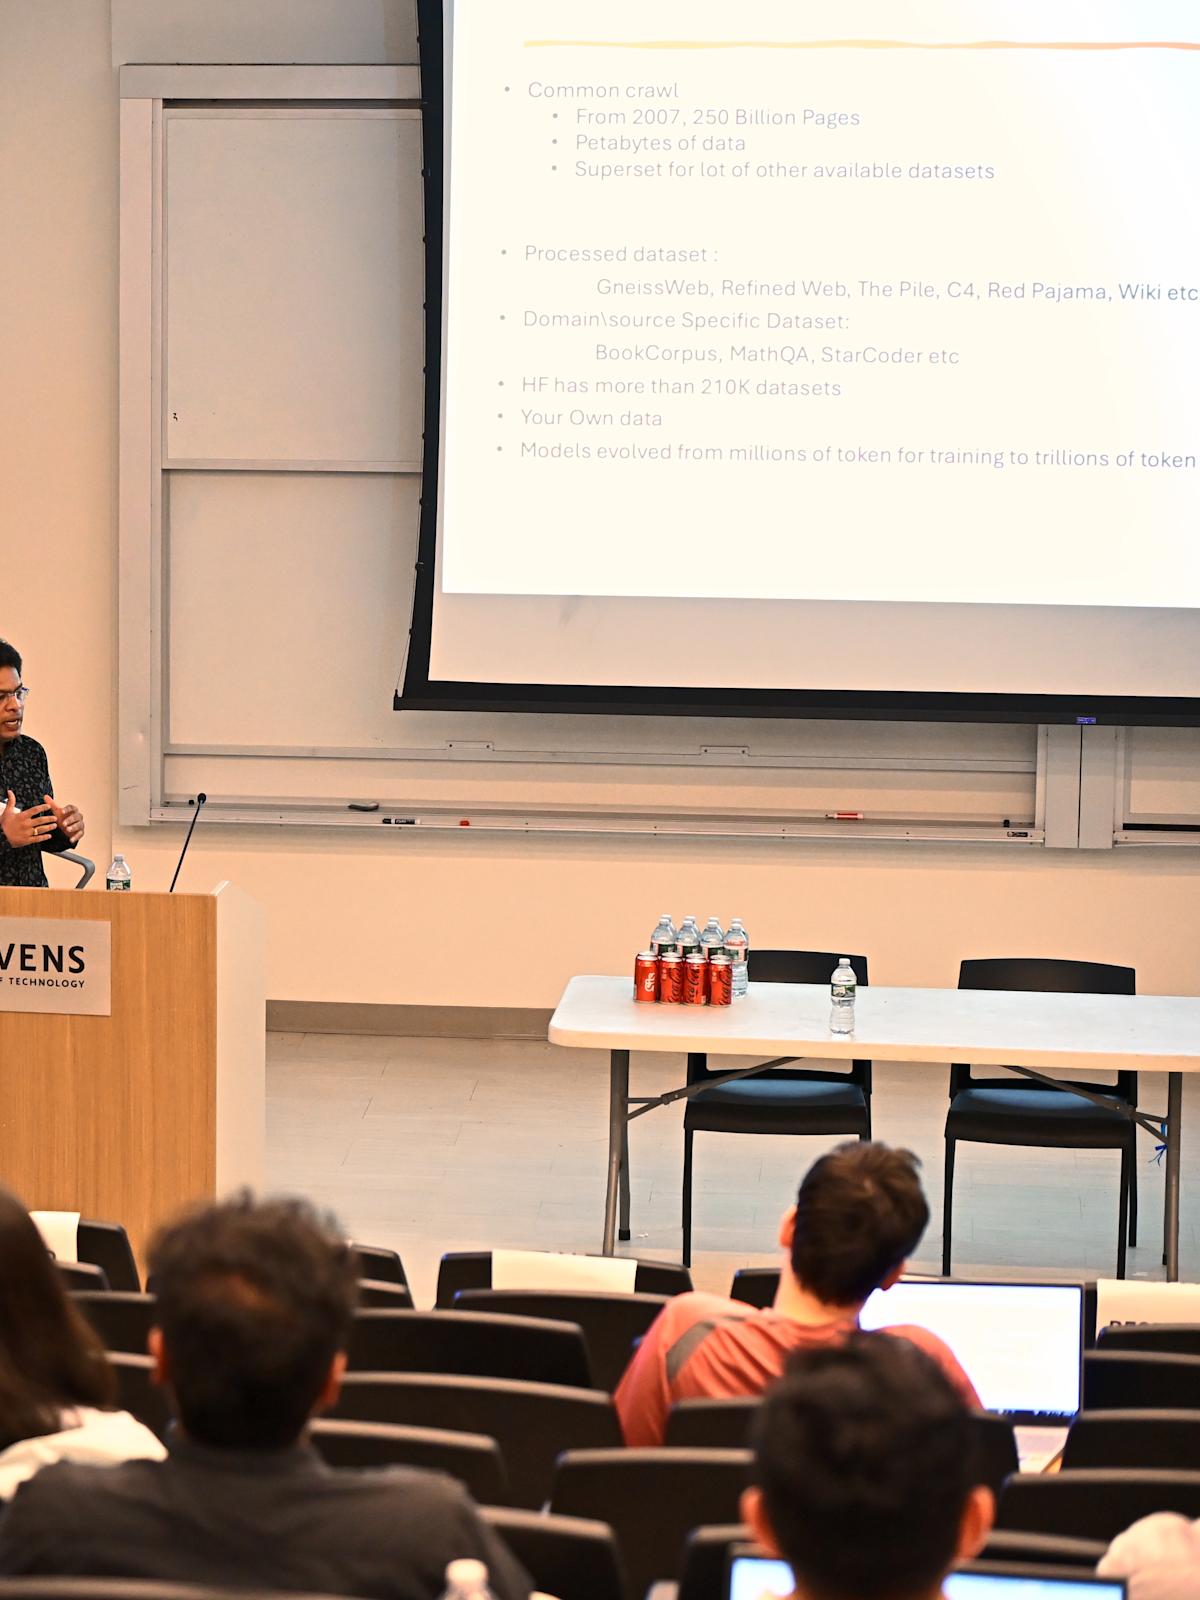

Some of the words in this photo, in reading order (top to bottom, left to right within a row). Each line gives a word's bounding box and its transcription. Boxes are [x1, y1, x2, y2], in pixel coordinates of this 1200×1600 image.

[528, 81, 620, 98] Common
[625, 82, 679, 99] crawl
[576, 107, 626, 125] From
[632, 108, 687, 127] 2007,
[692, 108, 729, 126] 250
[735, 108, 796, 126] Billion
[803, 108, 860, 130] Pages
[576, 133, 673, 155] Petabytes
[677, 134, 697, 151] of
[702, 135, 746, 152] data
[575, 160, 663, 181] Superset
[668, 160, 695, 178] for
[700, 161, 726, 178] lot
[731, 161, 751, 178] of
[756, 161, 808, 178] other
[813, 161, 902, 179] available
[908, 162, 995, 180] datasets
[525, 244, 628, 262] Processed
[633, 246, 707, 263] dataset
[596, 278, 714, 298] GneissWeb,
[721, 279, 796, 297] Refined
[801, 279, 851, 299] Web,
[857, 280, 893, 298] The
[899, 280, 940, 300] Pile,
[947, 281, 981, 301] C4,
[988, 281, 1025, 299] Red
[1032, 282, 1113, 303] Pajama,
[1118, 283, 1161, 300] Wiki
[1167, 285, 1199, 301] etc
[681, 311, 760, 332] Specific
[767, 312, 849, 330] Dataset:
[595, 343, 723, 365] BookCorpus,
[730, 345, 815, 366] MathQA,
[821, 346, 924, 364] StarCoder
[928, 349, 960, 365] etc
[522, 376, 549, 393] HF
[554, 376, 589, 393] has
[595, 381, 645, 394] more
[650, 378, 695, 394] than
[700, 378, 751, 395] 210K
[756, 378, 842, 397] datasets
[521, 408, 564, 425] Your
[569, 408, 614, 426] Own
[620, 409, 662, 427] data
[521, 441, 592, 459] Models
[596, 443, 672, 460] evolved
[677, 443, 723, 461] from
[729, 444, 807, 462] millions
[812, 445, 832, 462] of
[837, 446, 891, 463] token
[897, 446, 925, 464] for
[929, 447, 1005, 469] training
[1009, 450, 1029, 465] to
[1035, 448, 1110, 467] trillions
[1115, 450, 1135, 467] of
[1140, 451, 1196, 468] token
[9, 977, 86, 988] TECHNOLOGY
